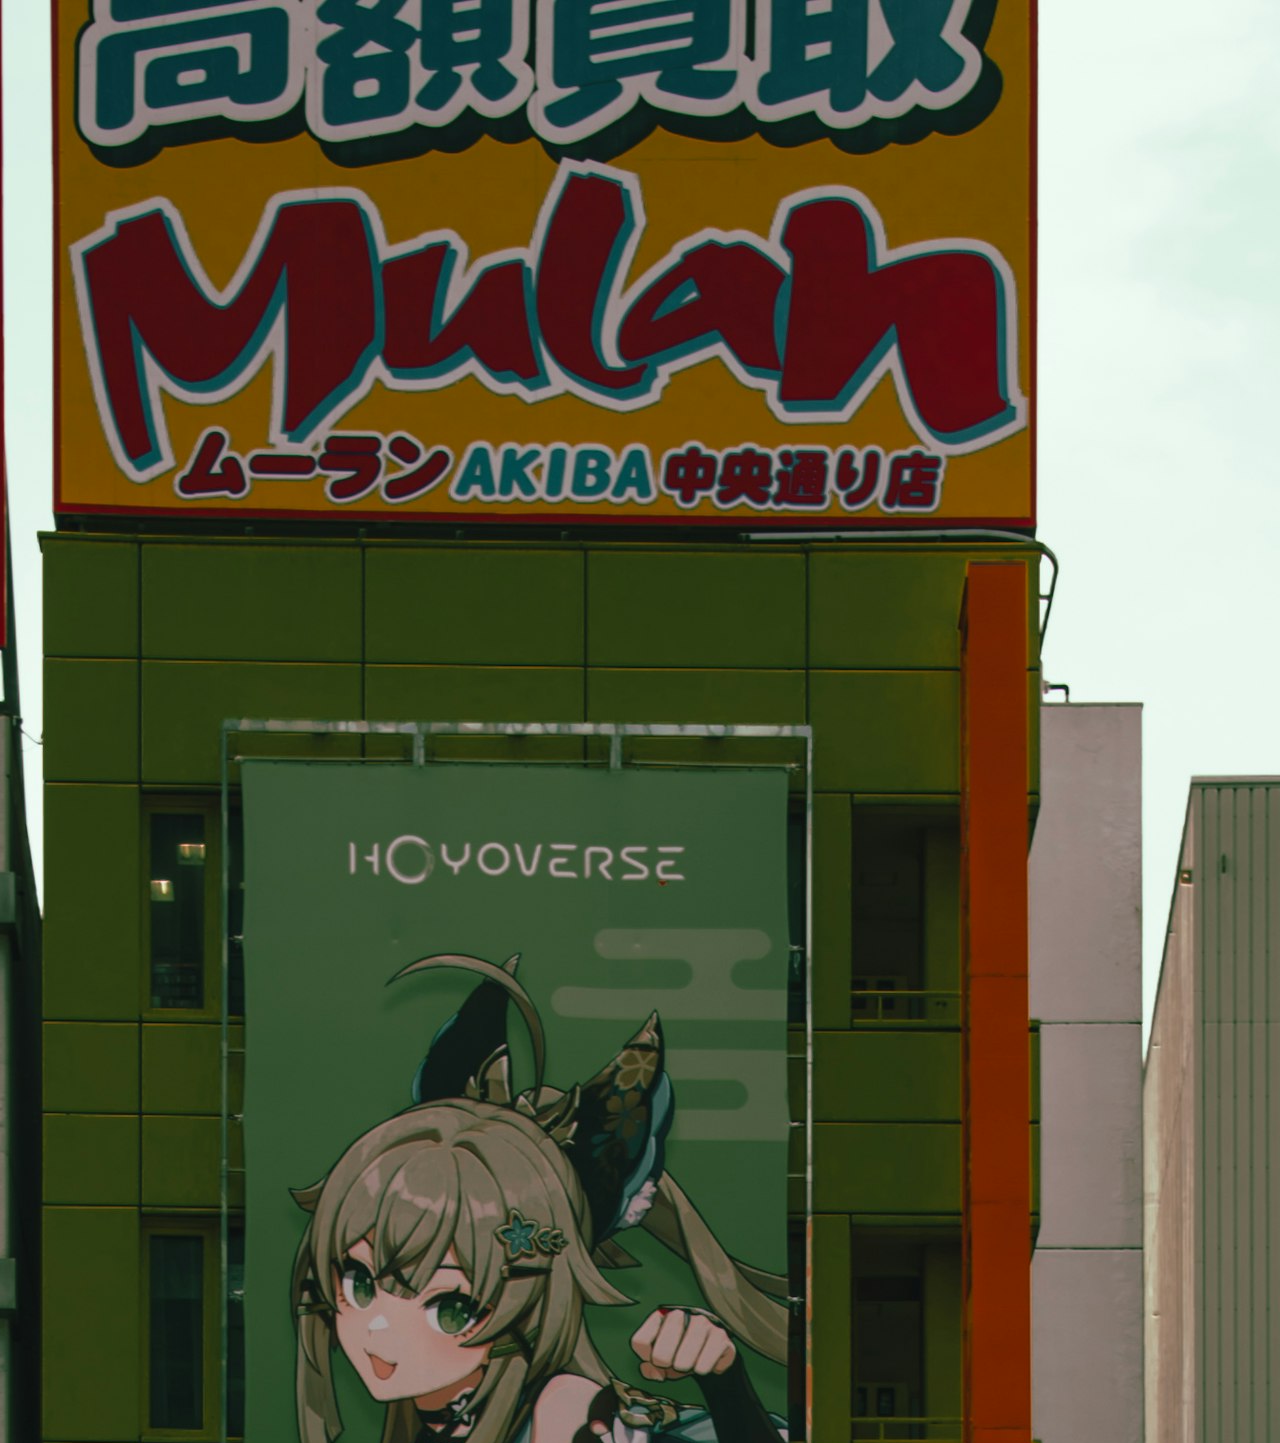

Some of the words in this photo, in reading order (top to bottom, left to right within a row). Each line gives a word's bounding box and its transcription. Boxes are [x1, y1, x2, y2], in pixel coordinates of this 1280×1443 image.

[72, 158, 1026, 481] Mulan
[175, 430, 448, 502] ムーラン
[455, 447, 655, 500] AKIBA
[661, 447, 945, 512] 中央通り店
[349, 834, 686, 884] HOYOVERSE
